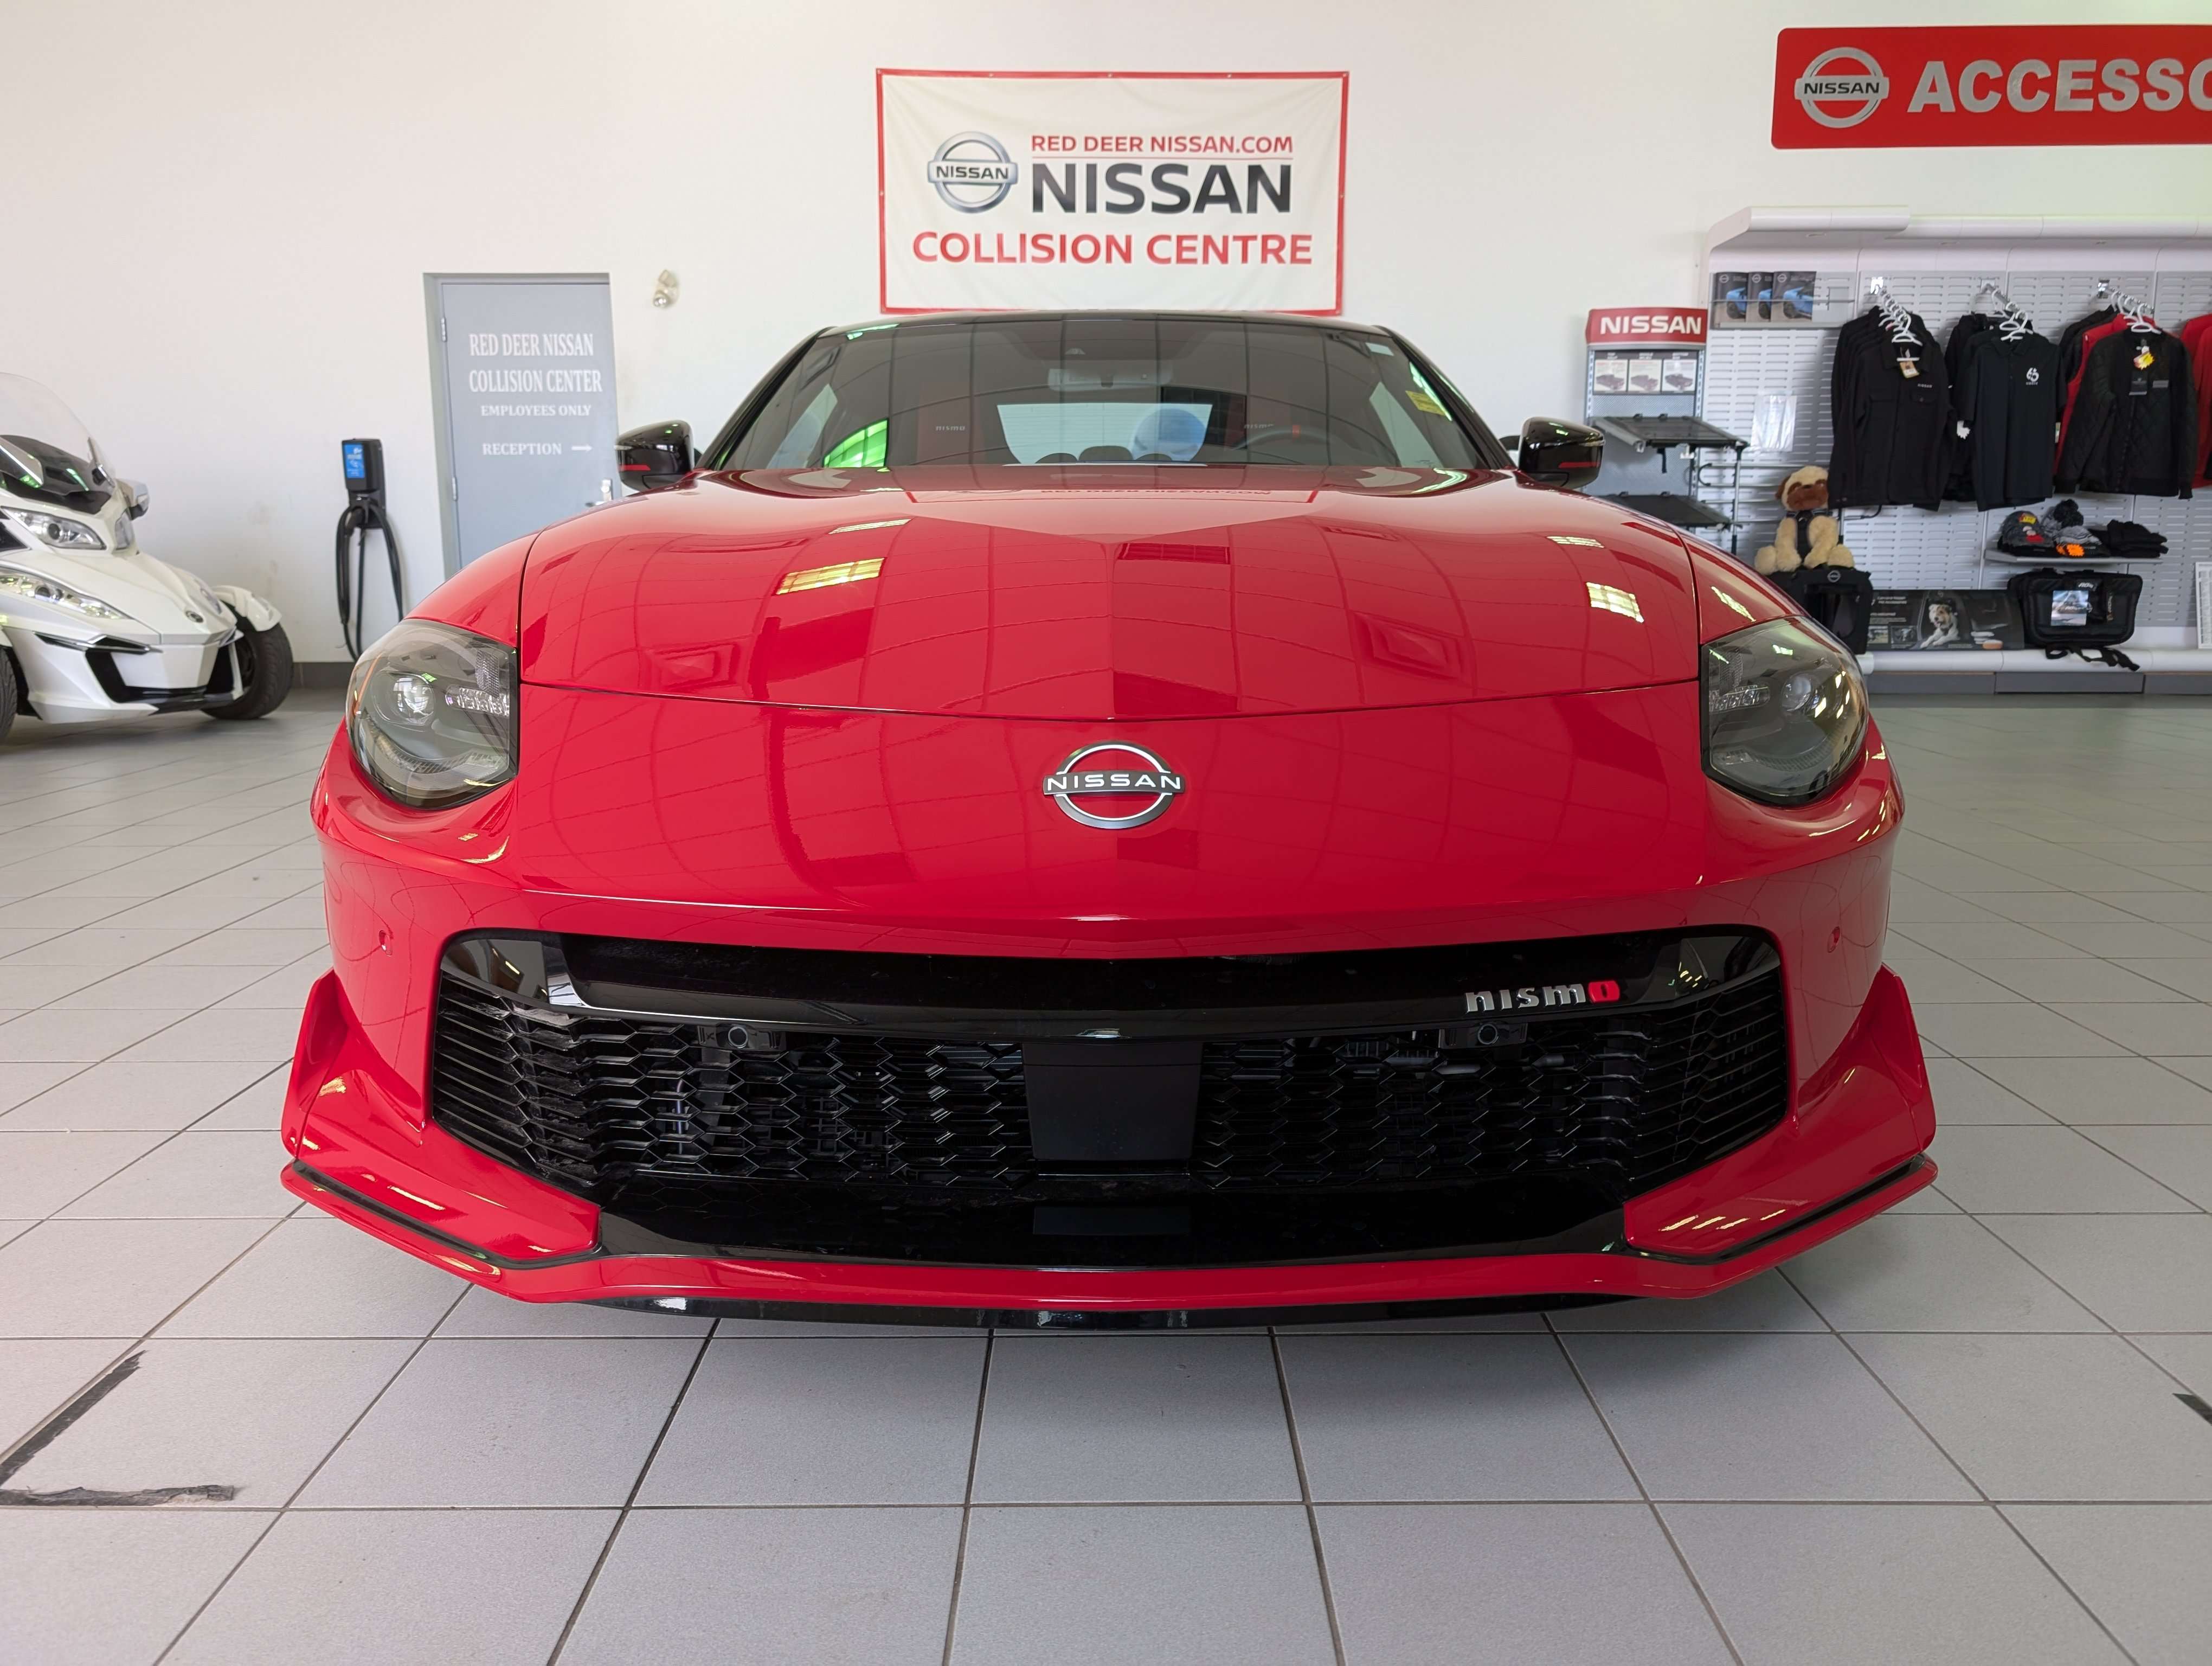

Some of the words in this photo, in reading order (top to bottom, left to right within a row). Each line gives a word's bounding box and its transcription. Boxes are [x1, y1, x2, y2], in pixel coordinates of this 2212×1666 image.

[1804, 82, 1880, 95] NISSAN
[1032, 136, 1077, 152] RED
[1084, 136, 1143, 152] DEER
[1151, 136, 1293, 153] NISSAN.COM
[936, 165, 1009, 180] NISSAN
[1032, 163, 1291, 214] NISSAN
[913, 232, 1133, 264] COLLISION
[1146, 234, 1312, 265] CENTRE
[1600, 316, 1701, 335] NISSAN
[469, 334, 499, 356] RED
[502, 334, 541, 356] DEER
[543, 334, 594, 356] NISSAN
[469, 369, 543, 392] COLLISION
[546, 370, 602, 392] CENTER
[481, 405, 556, 416] EMPLOYEES
[559, 405, 591, 416] ONLY
[483, 444, 562, 454] RECEPTION
[1047, 774, 1181, 791] NISSAN
[1465, 981, 1620, 1013] nismo
